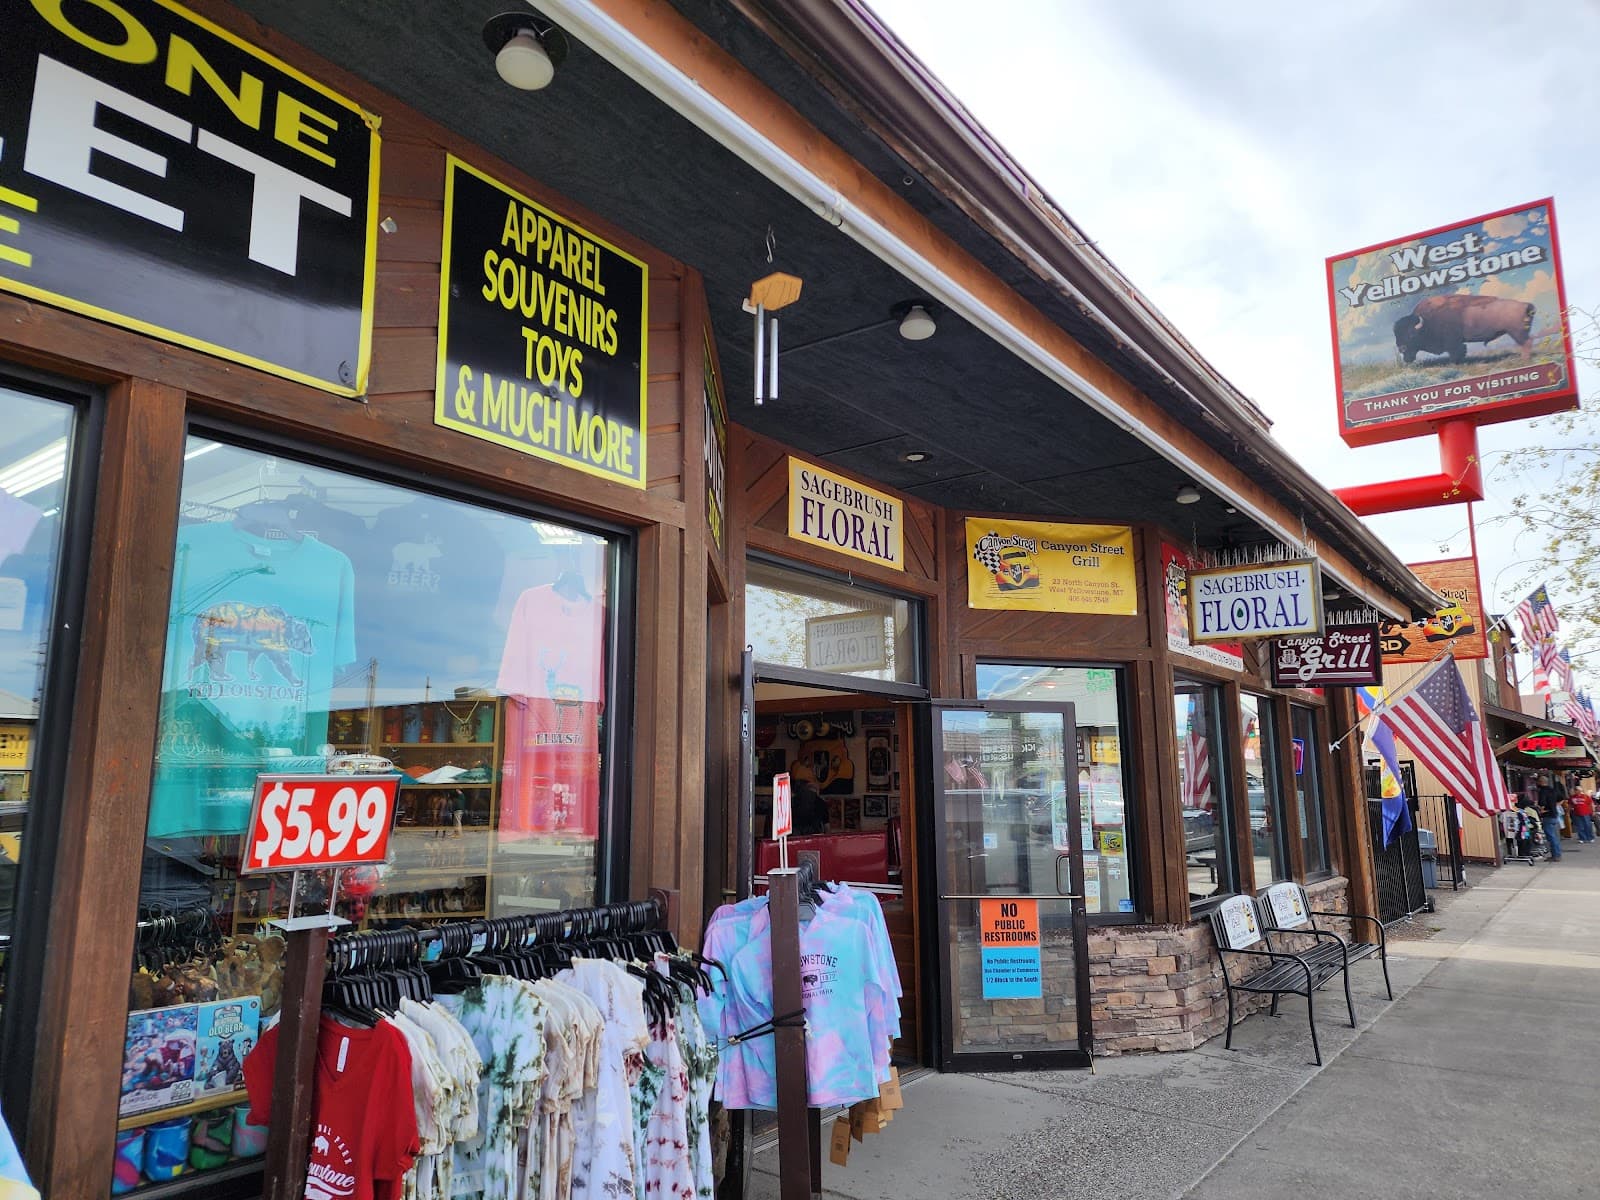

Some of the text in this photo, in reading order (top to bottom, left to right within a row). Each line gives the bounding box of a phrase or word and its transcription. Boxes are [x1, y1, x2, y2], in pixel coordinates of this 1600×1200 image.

[0, 53, 352, 276] ET
[501, 199, 605, 296] APPAREL
[1391, 231, 1484, 272] West
[1339, 245, 1546, 308] Yellowstone
[483, 251, 618, 356] SOUVENIRS
[521, 326, 583, 399] TOYS
[1364, 371, 1540, 412] THANK YOU FOR VISITING
[455, 365, 634, 475] & MUCH MORE
[800, 470, 894, 521] SAGEBRUSH
[800, 496, 895, 562] FLORAL
[1012, 535, 1038, 554] Street
[1040, 540, 1125, 555] Canyon Street
[1072, 555, 1100, 568] Grill
[1048, 586, 1067, 594] West
[1062, 578, 1082, 587] North
[1084, 580, 1109, 589] Canyon
[1203, 570, 1300, 596] SAGEBRUSH
[1440, 588, 1469, 603] Street
[1200, 593, 1308, 633] FLORAL
[1328, 632, 1371, 648] Street
[1300, 644, 1372, 681] Grill
[1517, 737, 1566, 751] OPEN
[255, 781, 388, 867] $5.99
[994, 919, 1025, 930] PUBLIC
[1001, 903, 1018, 917] NO
[984, 931, 1037, 942] RESTROOMS
[208, 1022, 244, 1038] OLD BEAR
